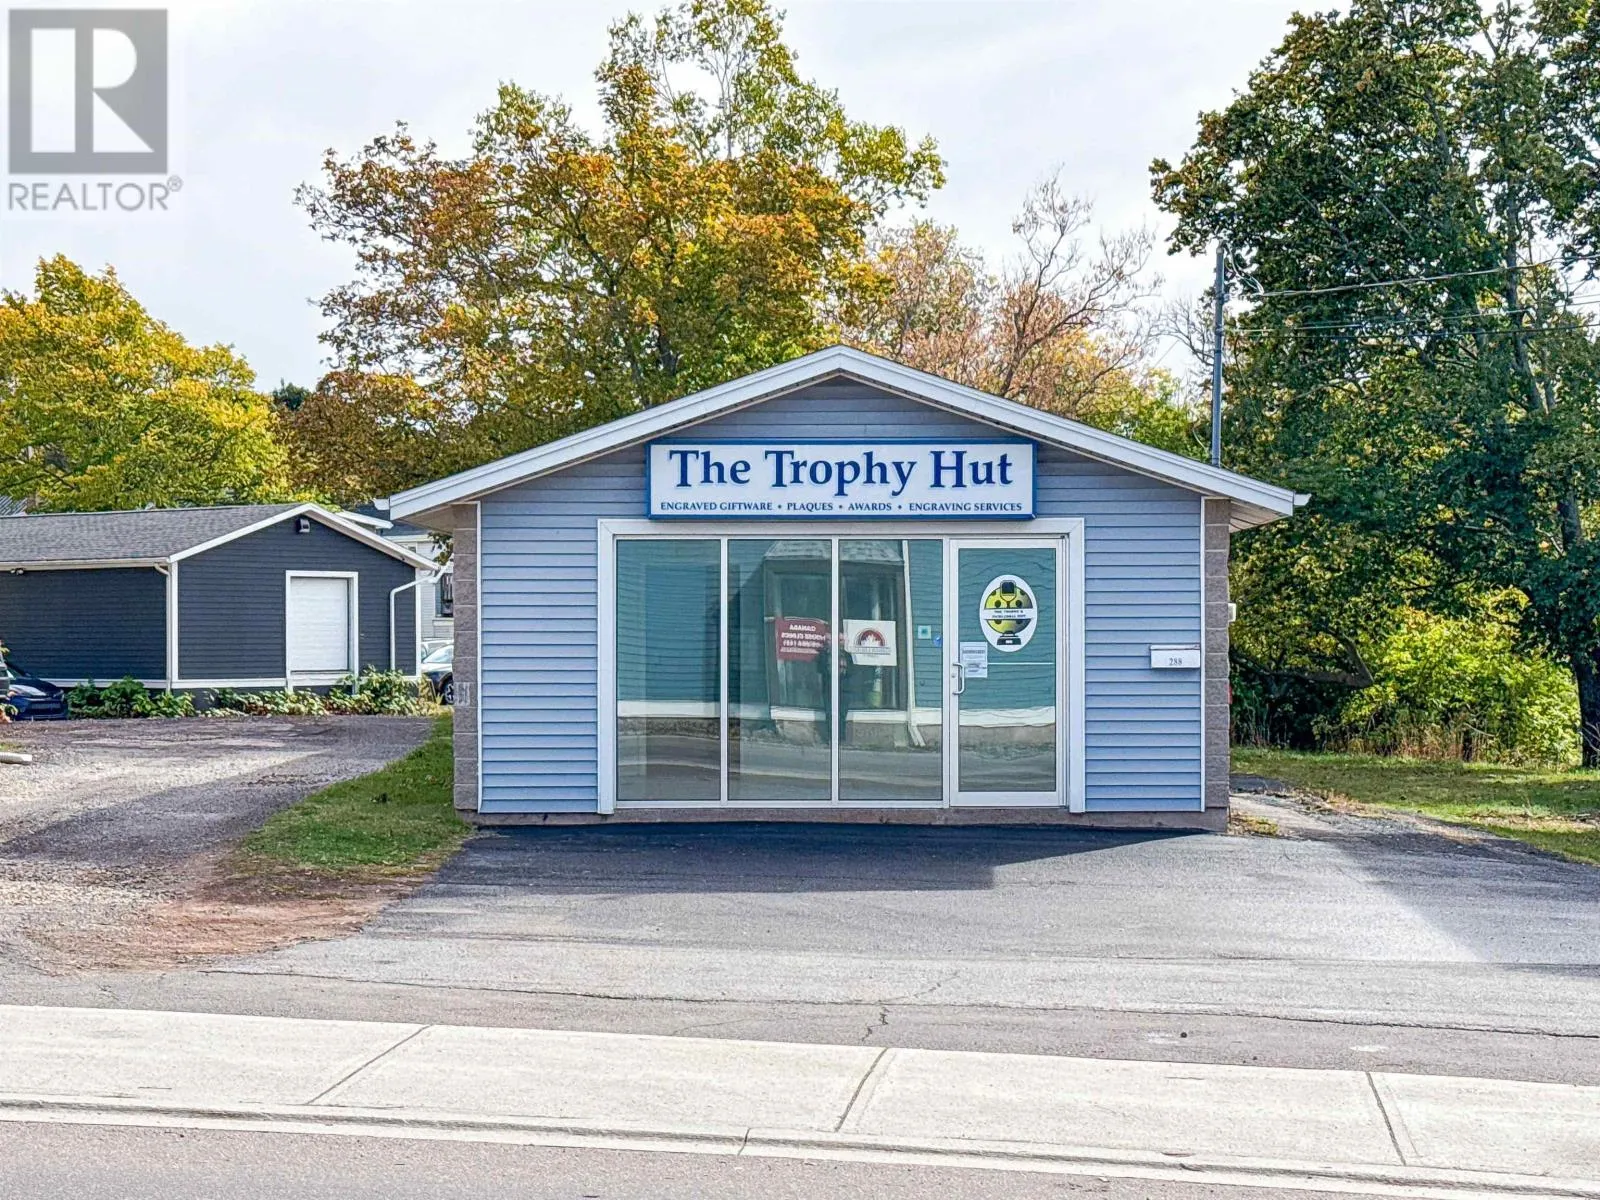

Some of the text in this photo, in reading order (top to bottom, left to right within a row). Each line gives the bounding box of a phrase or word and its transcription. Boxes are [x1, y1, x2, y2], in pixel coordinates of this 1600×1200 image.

[669, 450, 1013, 497] The Trophy Hut
[660, 502, 1022, 512] ENGRAVED GIFTWARE PLAQUES AWARDS ENGRAVING SERVICES
[1169, 657, 1183, 666] 288
